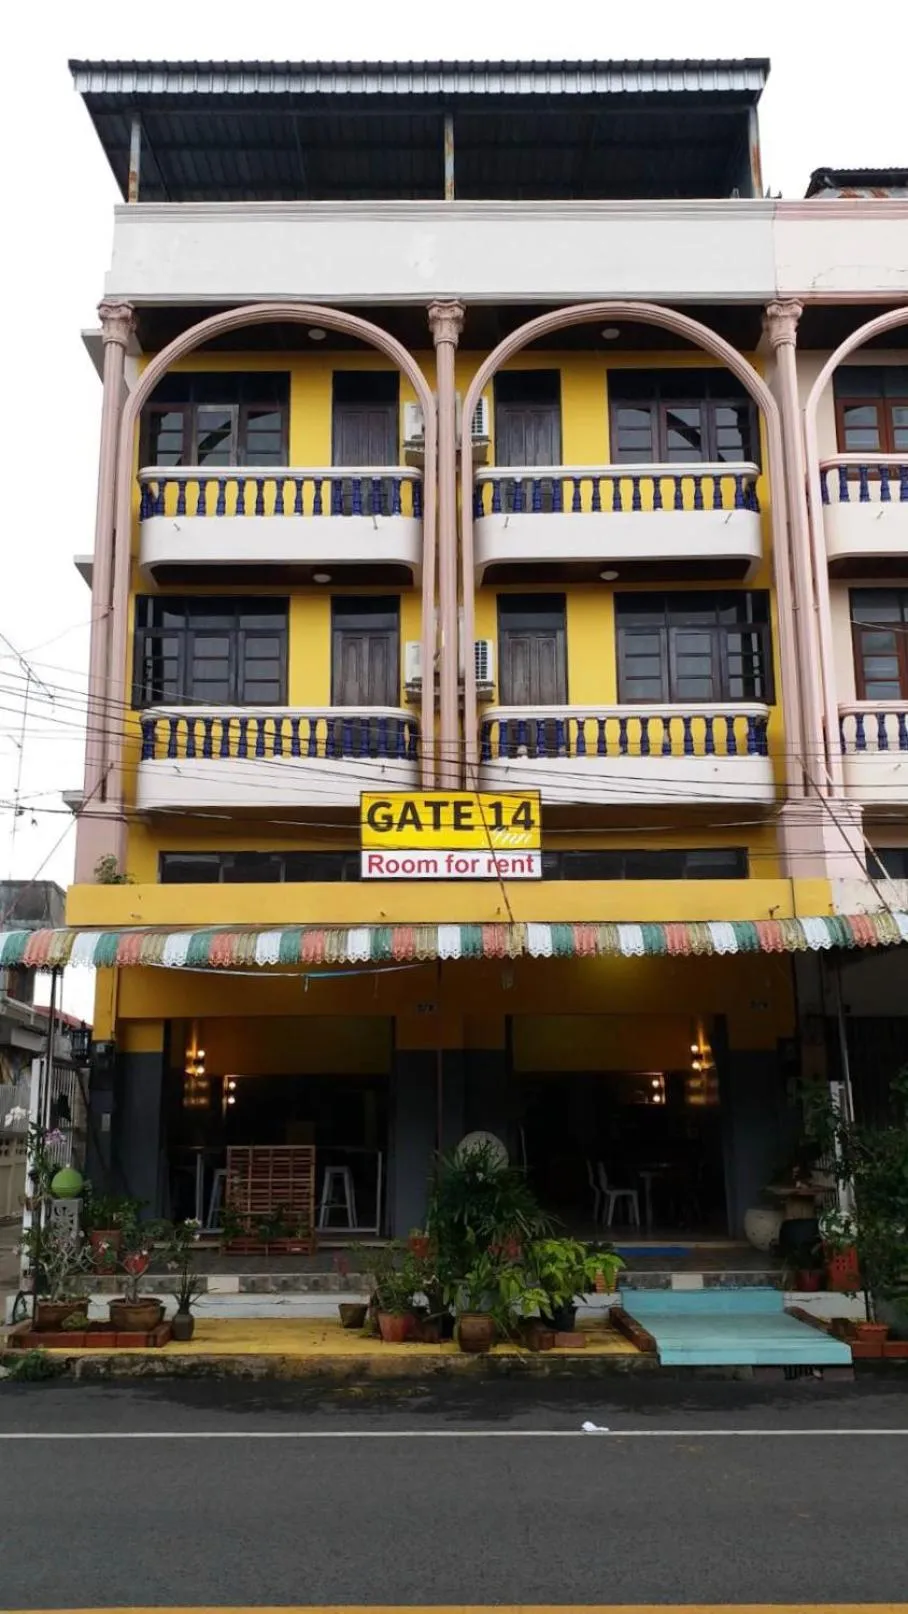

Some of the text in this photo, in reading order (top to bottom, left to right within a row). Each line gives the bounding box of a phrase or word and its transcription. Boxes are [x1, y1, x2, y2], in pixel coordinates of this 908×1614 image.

[366, 801, 535, 832] GATE 14
[368, 854, 535, 874] Room for rent
